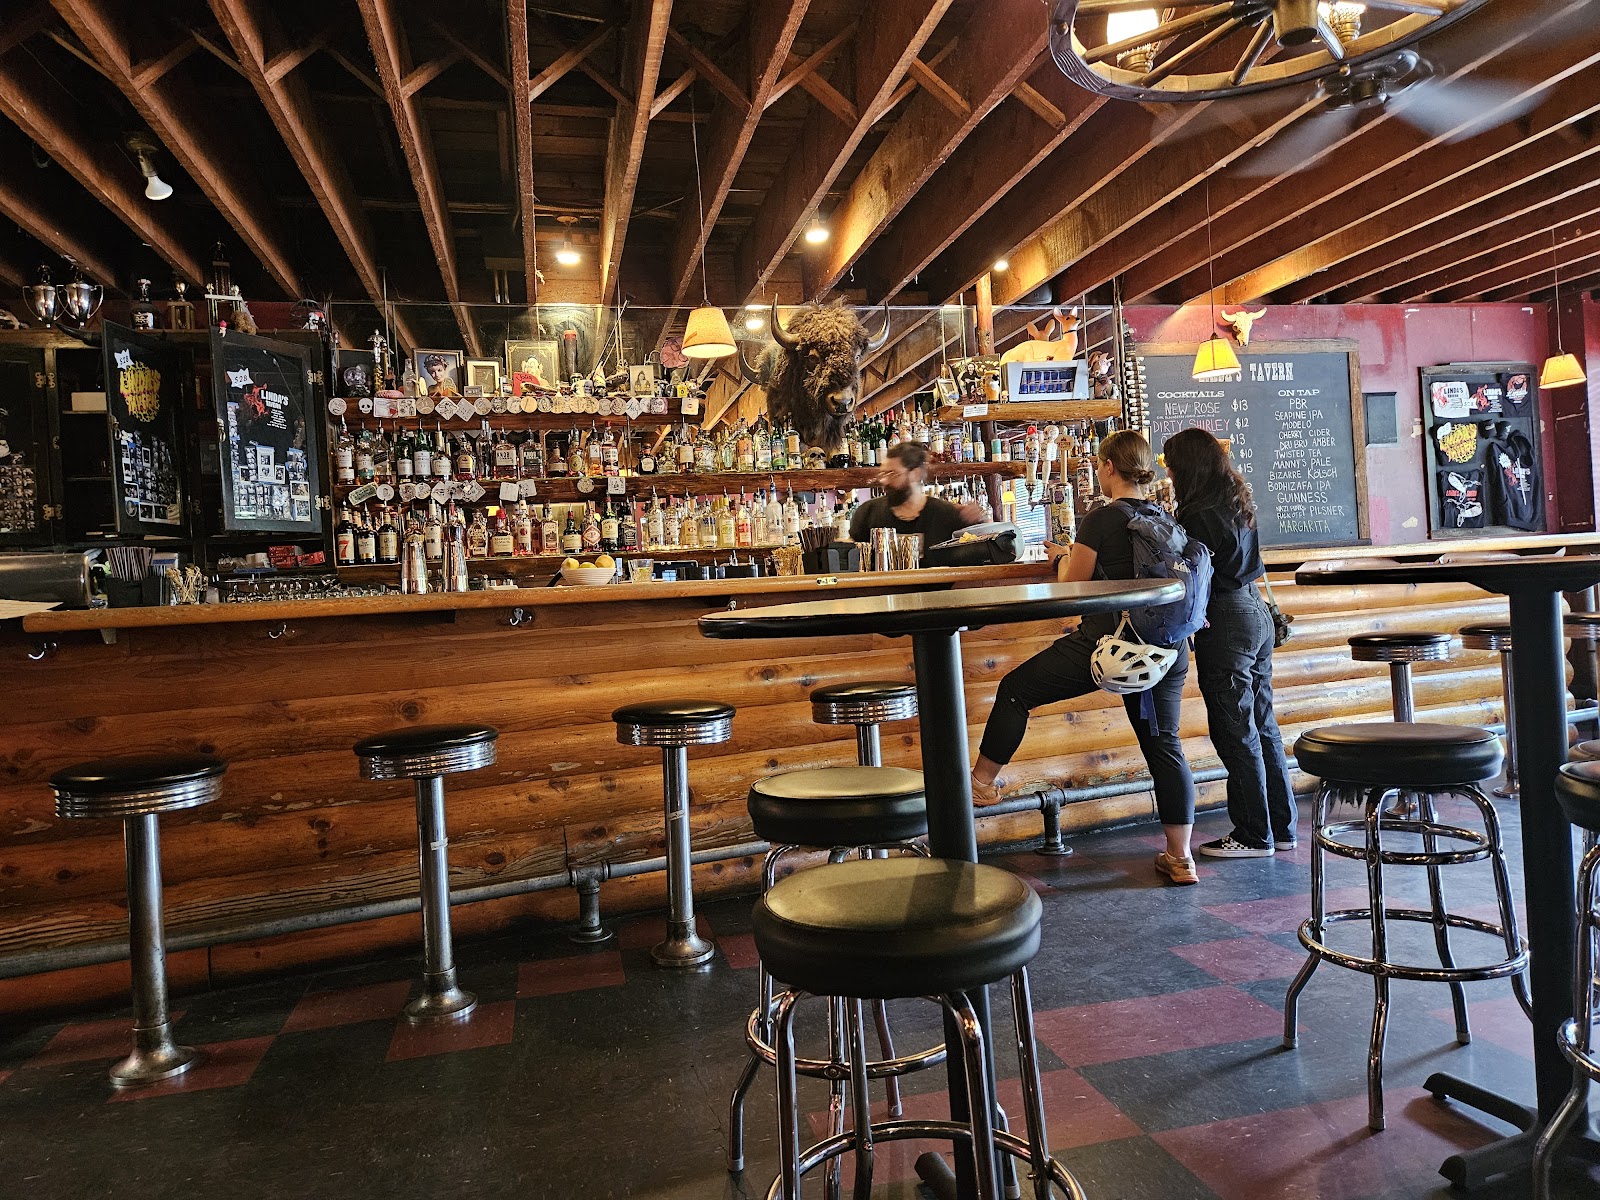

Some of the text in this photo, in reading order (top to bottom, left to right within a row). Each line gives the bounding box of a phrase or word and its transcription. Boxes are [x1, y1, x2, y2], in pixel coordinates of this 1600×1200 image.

[1250, 362, 1294, 381] TAVERN
[234, 375, 248, 384] $28
[261, 390, 289, 406] LINDA'S
[1157, 390, 1225, 399] COCKTAILS
[1278, 389, 1295, 397] ON
[1164, 398, 1249, 415] NEW ROSE $13
[1289, 398, 1308, 410] PBR
[1275, 410, 1324, 421] SEAPINE IPA
[1153, 421, 1183, 434] DIRTY
[1188, 419, 1230, 432] SHIRLEY
[1235, 417, 1250, 430] $12
[1282, 420, 1312, 430] MODELO
[1230, 433, 1246, 445] $13
[1279, 428, 1331, 440] CHERRY CIDER
[1280, 437, 1336, 451] DRU BRU AMBER
[1240, 448, 1253, 459] $10
[1274, 449, 1322, 459] TWISTED TEA
[1237, 463, 1253, 473] $15
[1311, 457, 1331, 470] PALE
[1270, 470, 1302, 480] BIZARRE
[1268, 480, 1332, 492] BODHIZAFA IPA
[1277, 492, 1328, 503] GUINNESS
[1309, 505, 1345, 517] PILSNER
[1280, 519, 1331, 534] MARGARITA
